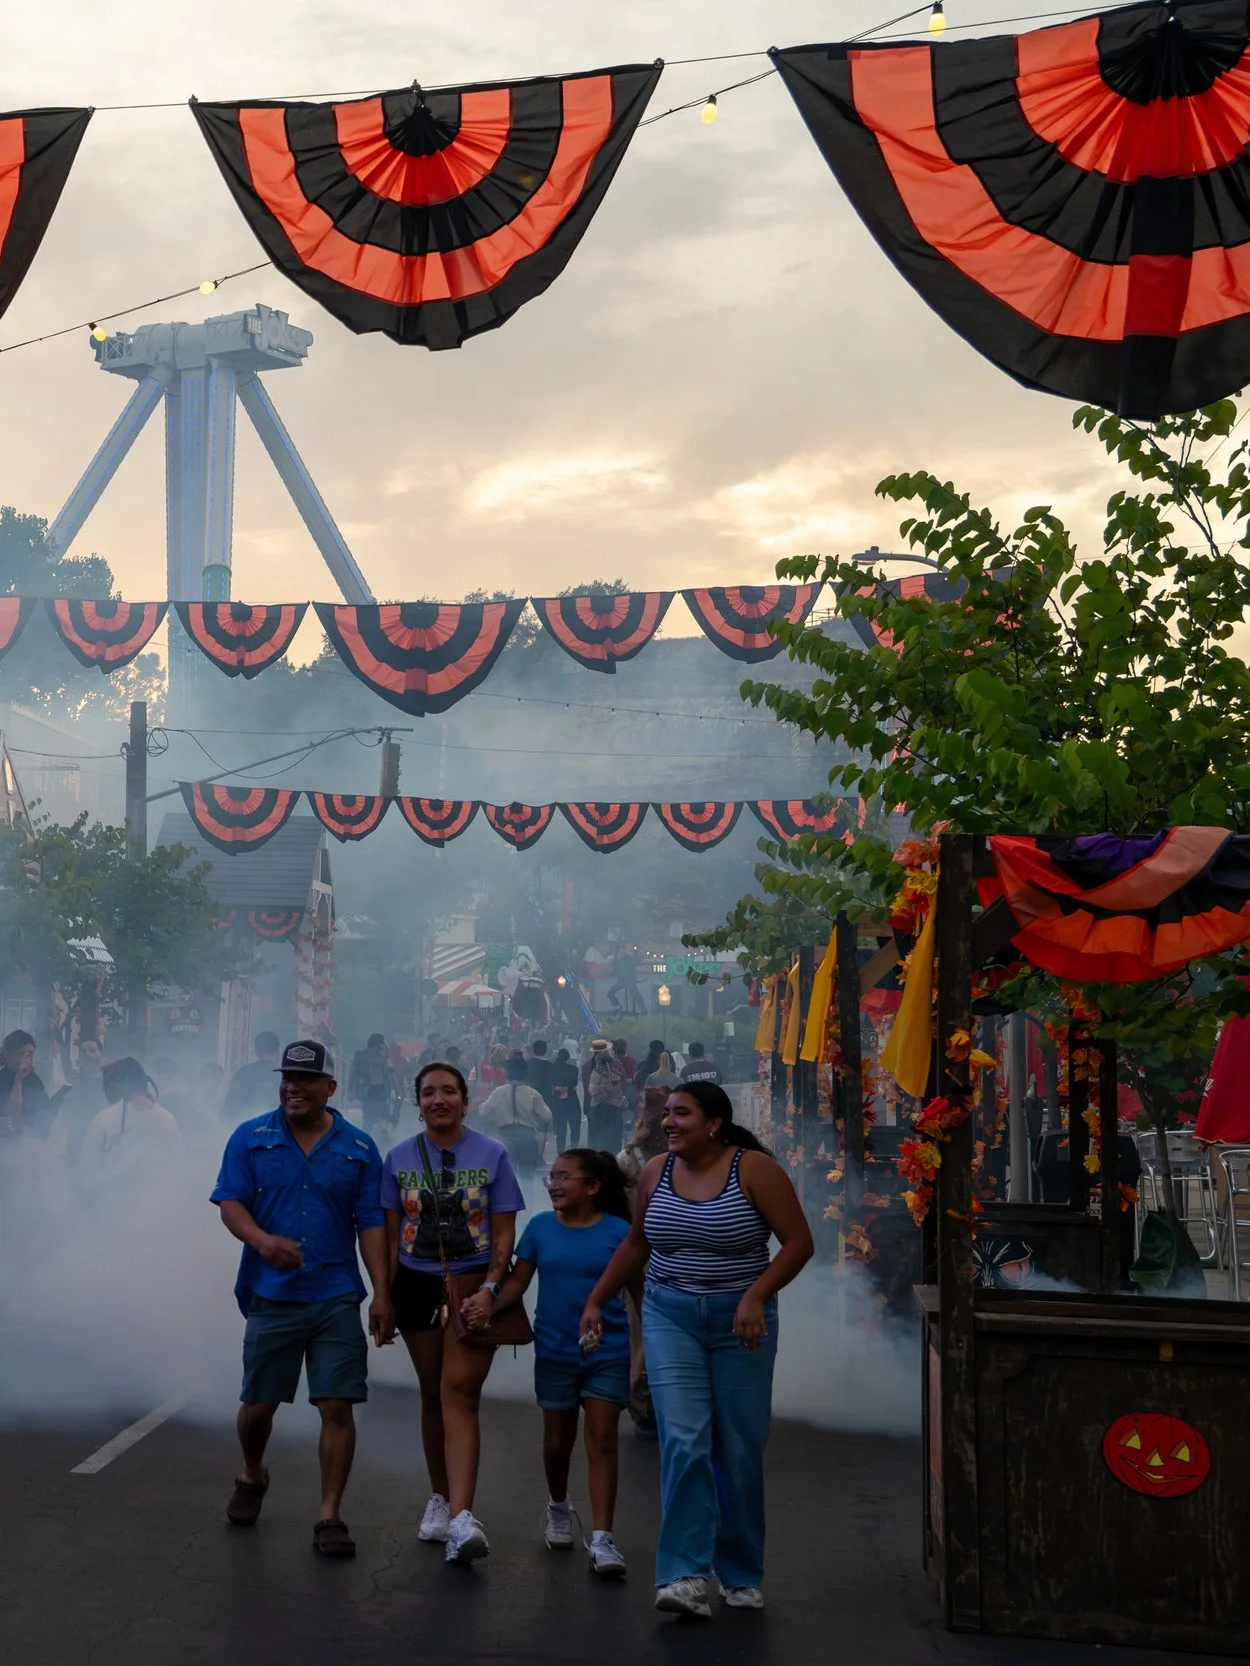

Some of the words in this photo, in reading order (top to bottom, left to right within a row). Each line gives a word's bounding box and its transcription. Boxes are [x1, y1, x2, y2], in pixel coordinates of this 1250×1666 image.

[247, 317, 262, 334] THE
[653, 964, 667, 973] THE
[396, 1167, 489, 1189] PANTERS
